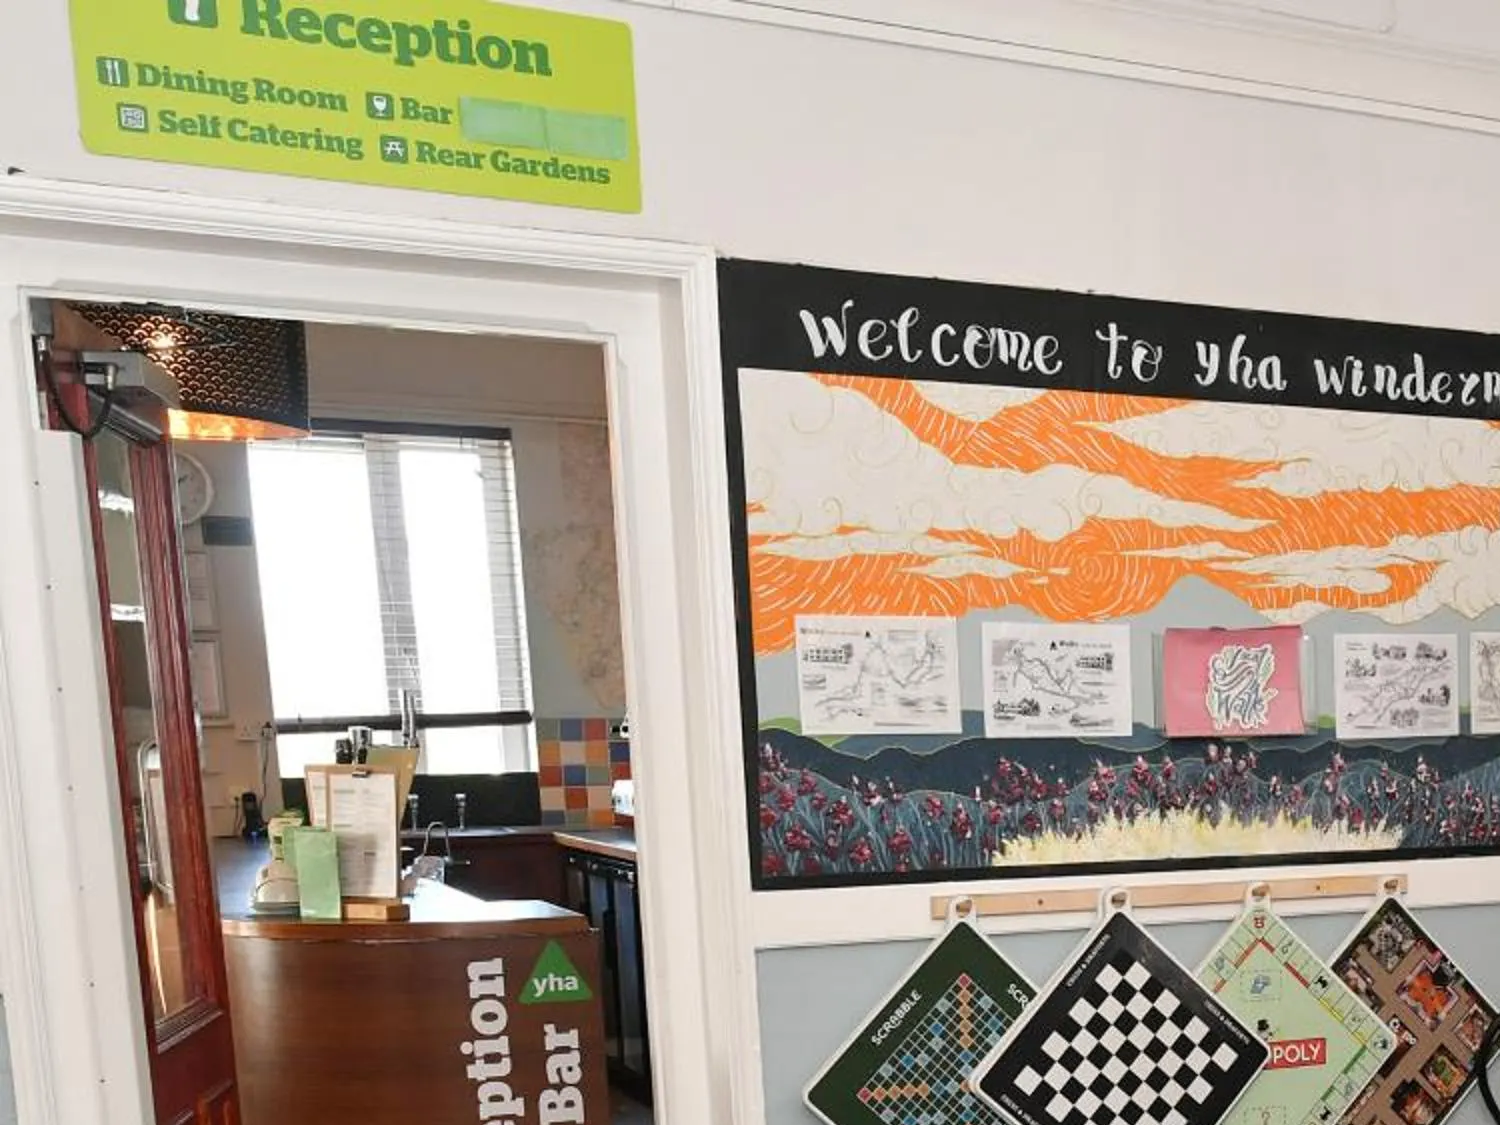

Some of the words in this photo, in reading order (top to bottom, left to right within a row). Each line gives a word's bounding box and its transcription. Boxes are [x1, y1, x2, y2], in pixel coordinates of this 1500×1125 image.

[240, 0, 552, 76] Reception
[134, 62, 249, 104] Dining
[252, 78, 348, 113] Room
[401, 97, 453, 125] Bar
[158, 109, 222, 137] Self
[227, 118, 364, 160] Catering
[416, 140, 486, 170] Rear
[490, 150, 611, 185] Gardens
[1096, 322, 1163, 381] to
[1194, 334, 1287, 393] yha
[533, 970, 580, 997] yha
[870, 989, 923, 1047] SCRABBLE
[1272, 1042, 1320, 1063] POLY
